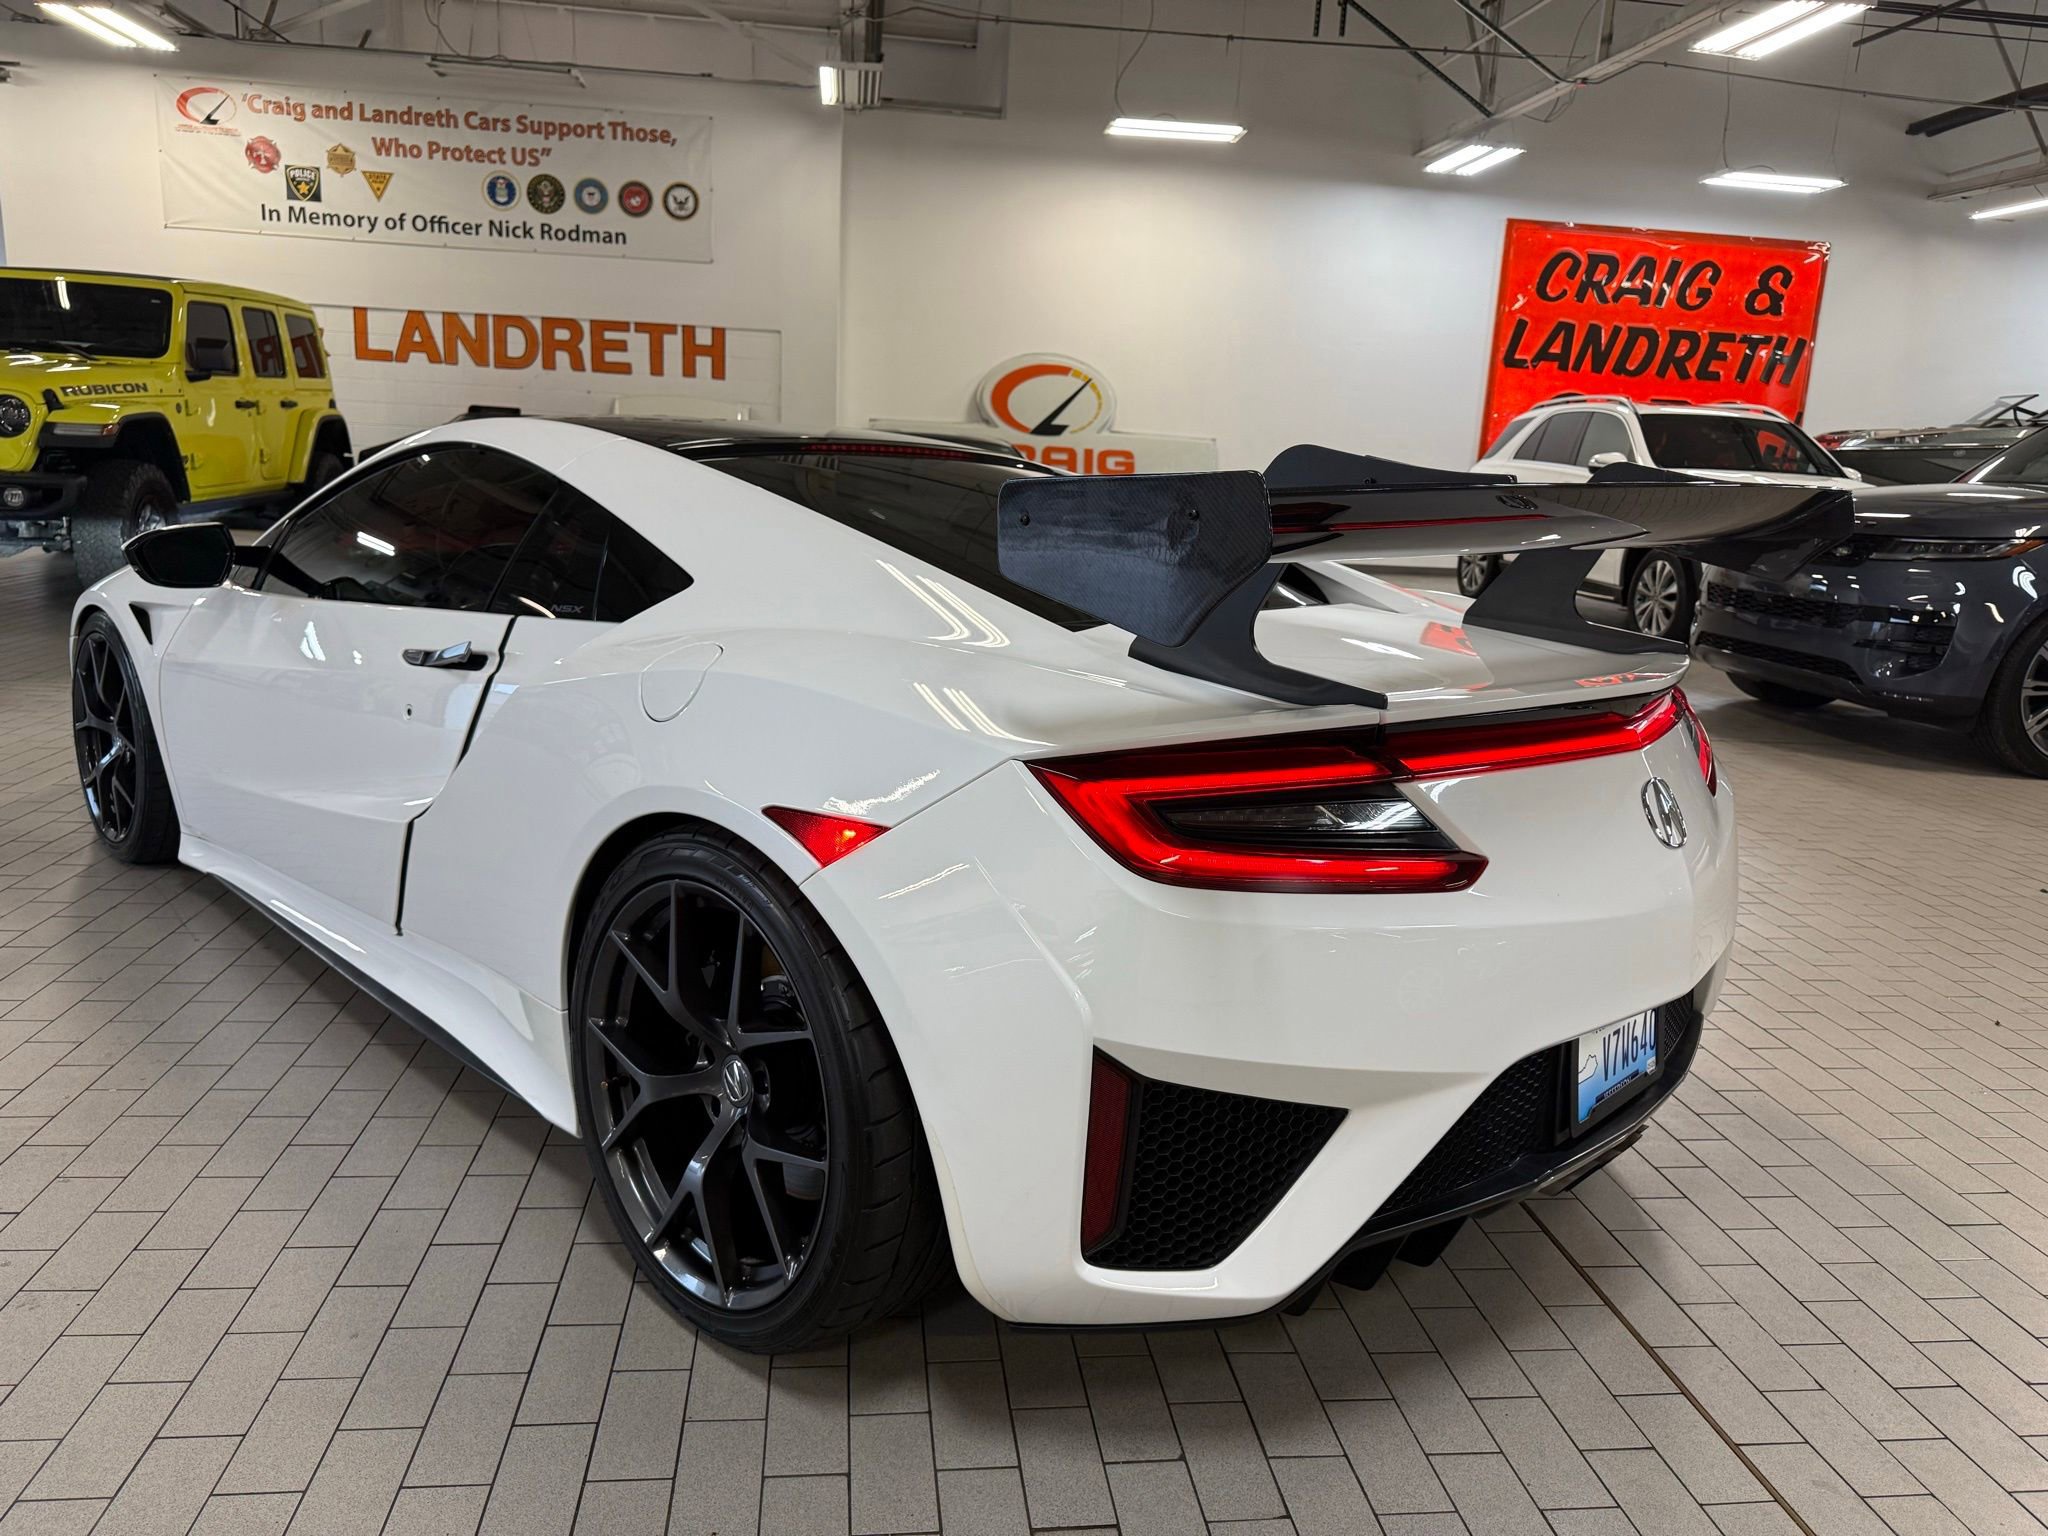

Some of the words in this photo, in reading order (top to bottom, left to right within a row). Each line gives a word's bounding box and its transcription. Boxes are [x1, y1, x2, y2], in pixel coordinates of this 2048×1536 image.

[311, 102, 353, 121] and
[359, 103, 459, 130] Landreth
[463, 111, 511, 133] Cars
[516, 115, 605, 141] Support
[608, 121, 678, 147] Those,
[371, 136, 423, 160] Who
[427, 140, 506, 165] Protect
[261, 203, 281, 222] In
[288, 205, 378, 234] Memory
[384, 212, 407, 231] of
[411, 214, 482, 236] Officer
[488, 220, 534, 240] Nick
[540, 223, 628, 245] Rodman
[1536, 249, 1722, 312] CRAIG
[1744, 265, 1794, 317] &
[353, 306, 727, 381] LANDRETH
[1502, 317, 1808, 386] LANDRETH
[60, 382, 149, 397] RUBICON
[1012, 444, 1135, 476] AIG
[551, 603, 584, 614] NSX
[1602, 1008, 1656, 1082] V7W640
